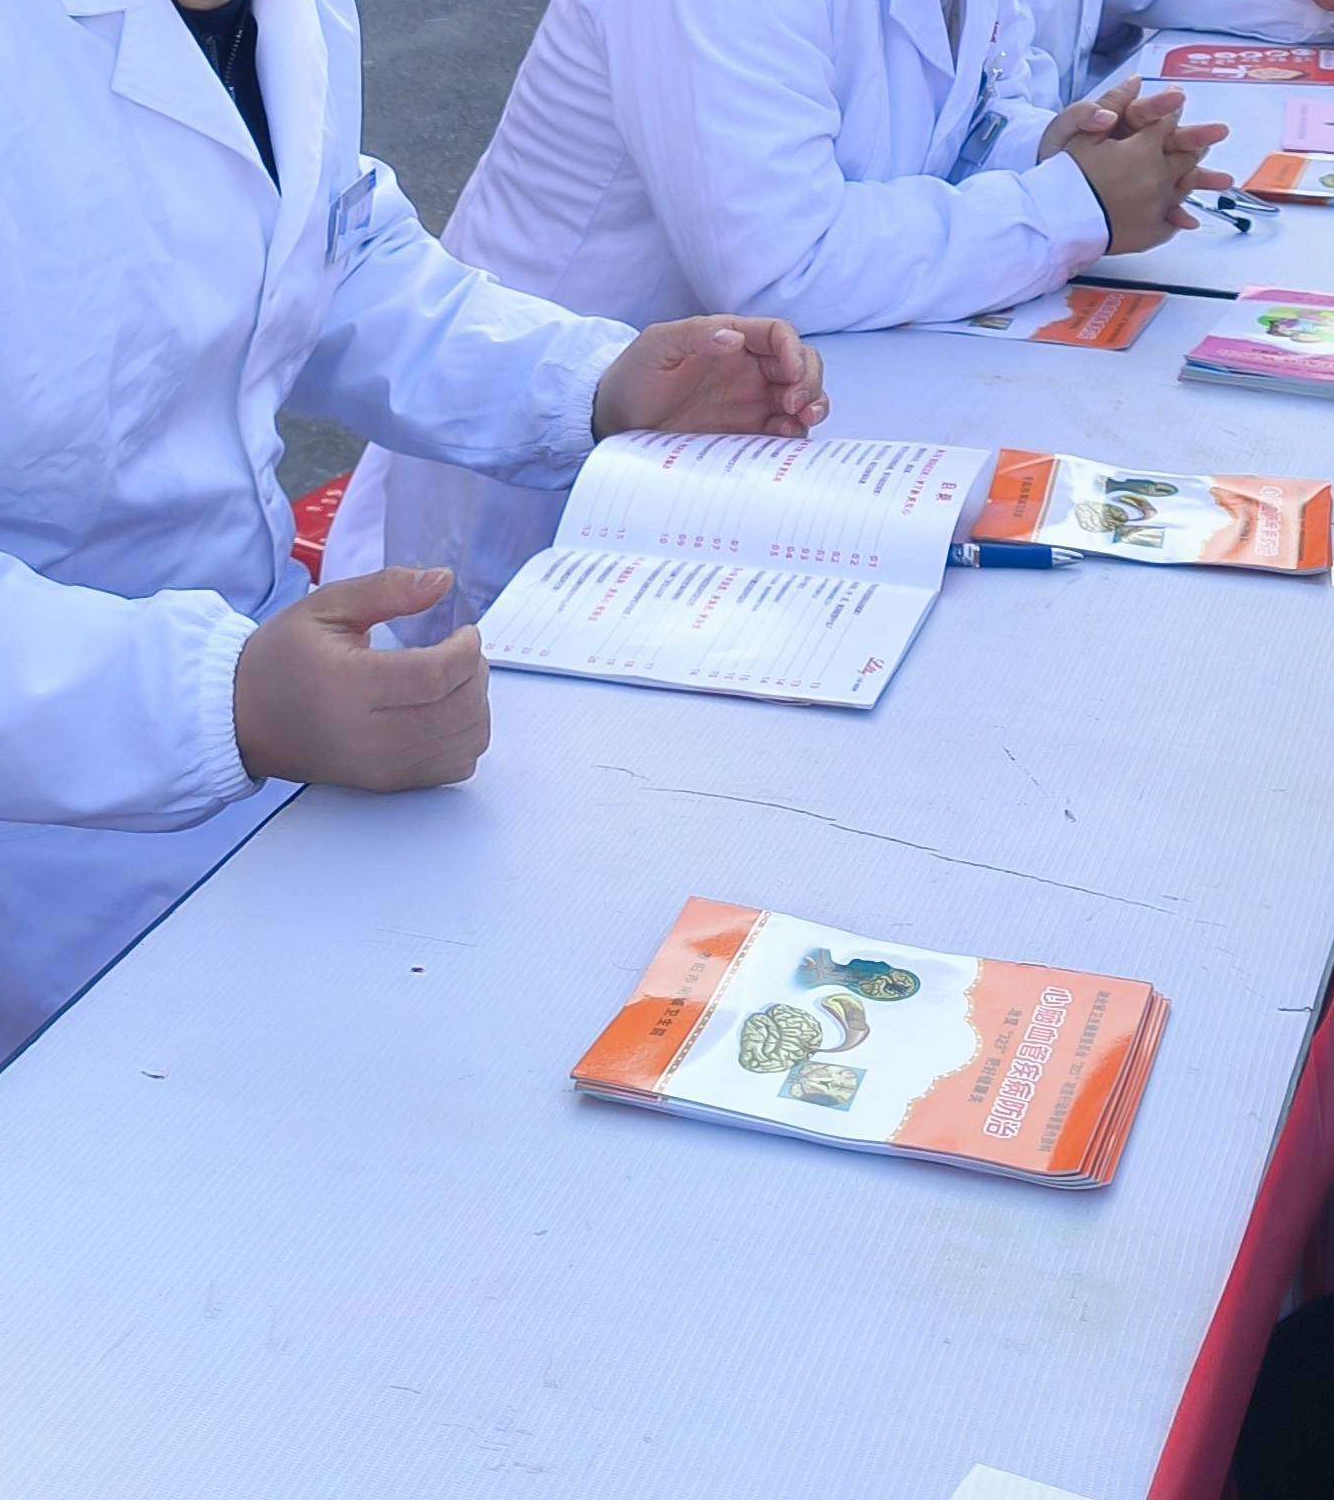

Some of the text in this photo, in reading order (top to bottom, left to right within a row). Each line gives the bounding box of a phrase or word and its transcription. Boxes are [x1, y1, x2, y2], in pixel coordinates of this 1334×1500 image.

[980, 985, 1075, 1141] 心脑血管疾病防治
